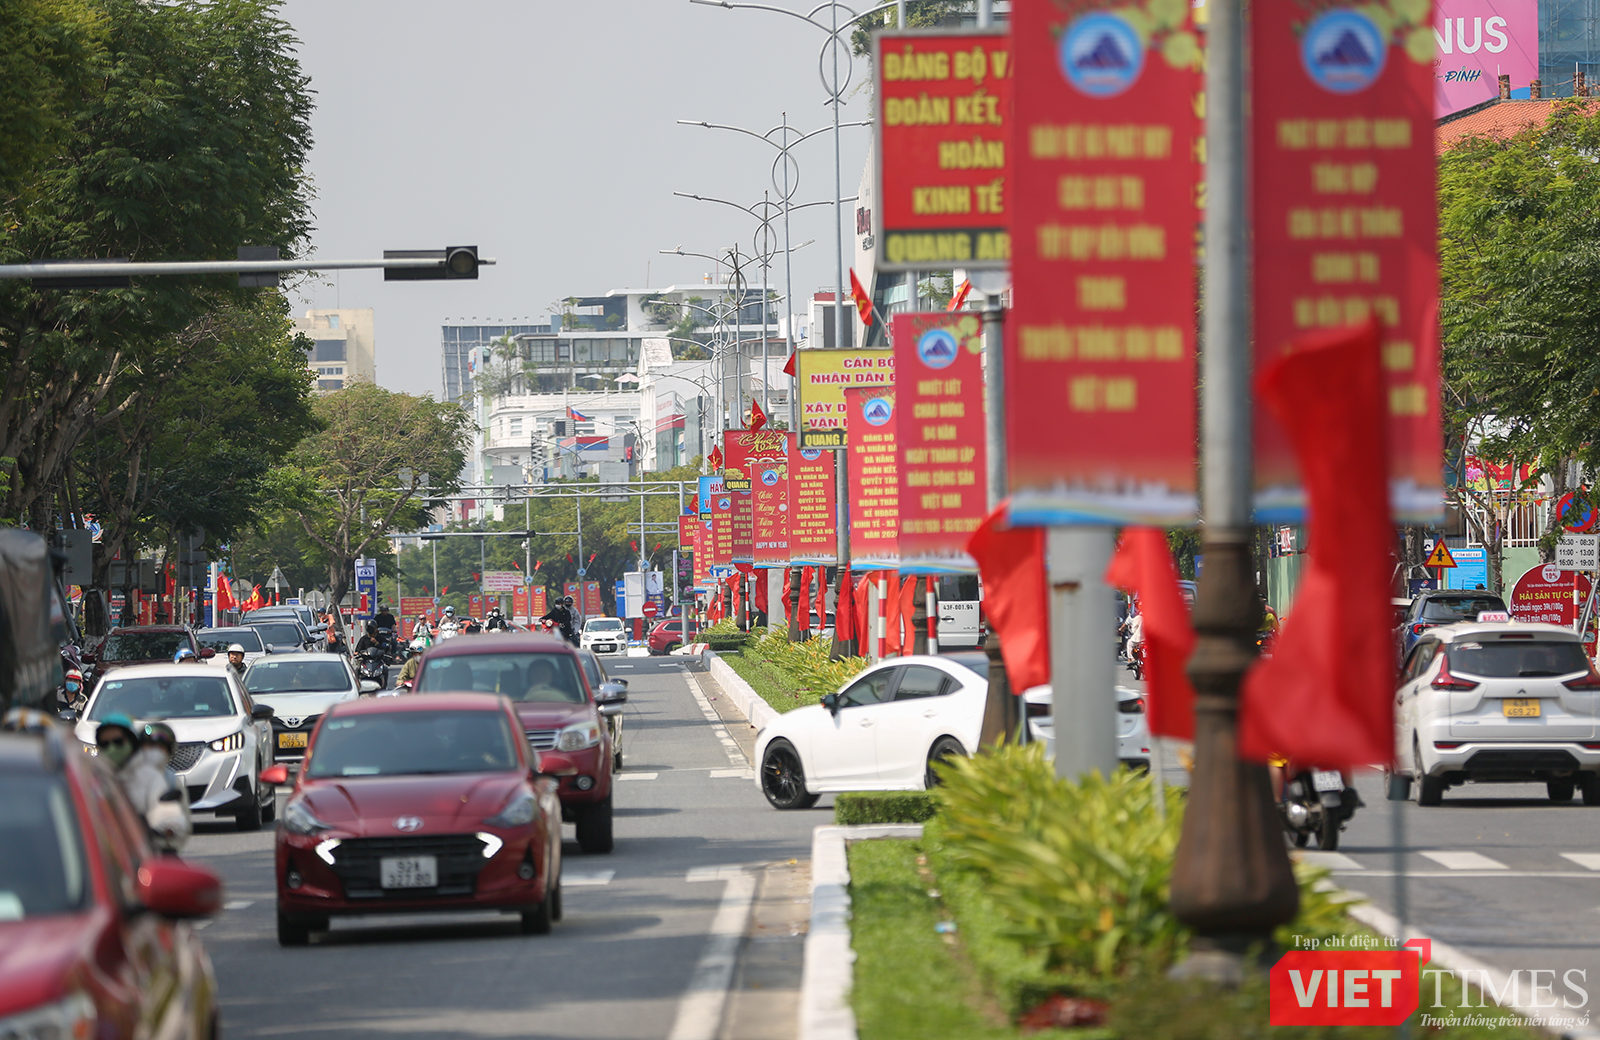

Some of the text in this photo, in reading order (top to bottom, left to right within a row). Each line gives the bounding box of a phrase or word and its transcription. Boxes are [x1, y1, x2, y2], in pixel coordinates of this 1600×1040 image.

[884, 44, 950, 81] ĐẢNG
[954, 45, 987, 85] BỘ
[885, 87, 1003, 127] ĐOÀN KẾT,
[939, 136, 1005, 169] HOÀN
[912, 178, 1005, 214] KINH TẾ
[885, 232, 972, 263] QUANG
[844, 356, 896, 369] CÁN BỘ
[811, 372, 851, 383] NHÂN
[856, 372, 885, 383] DÂN
[918, 378, 962, 397] NHIỆT LIỆT
[805, 402, 832, 413] XÂY
[809, 417, 838, 428] VĂN
[805, 434, 840, 446] QUANG
[863, 433, 894, 443] ĐẢNG BỘ
[856, 445, 866, 453] VÀ
[867, 444, 886, 453] NHÂN
[864, 454, 895, 464] ĐÀ NẴNG
[862, 465, 883, 475] ĐOÀN
[726, 481, 749, 489] QUANG
[861, 476, 883, 486] QUYẾT
[710, 482, 723, 492] HÃY
[864, 487, 883, 496] PHẤN
[858, 498, 879, 507] HOÀN
[864, 508, 874, 518] KẾ
[853, 520, 871, 528] KINH
[872, 519, 881, 528] TẾ
[864, 530, 880, 539] NĂM
[1519, 590, 1586, 601] HẢI SẢN TỰ CHN
[1483, 613, 1507, 622] TAXI
[1508, 708, 1536, 716] 469.27
